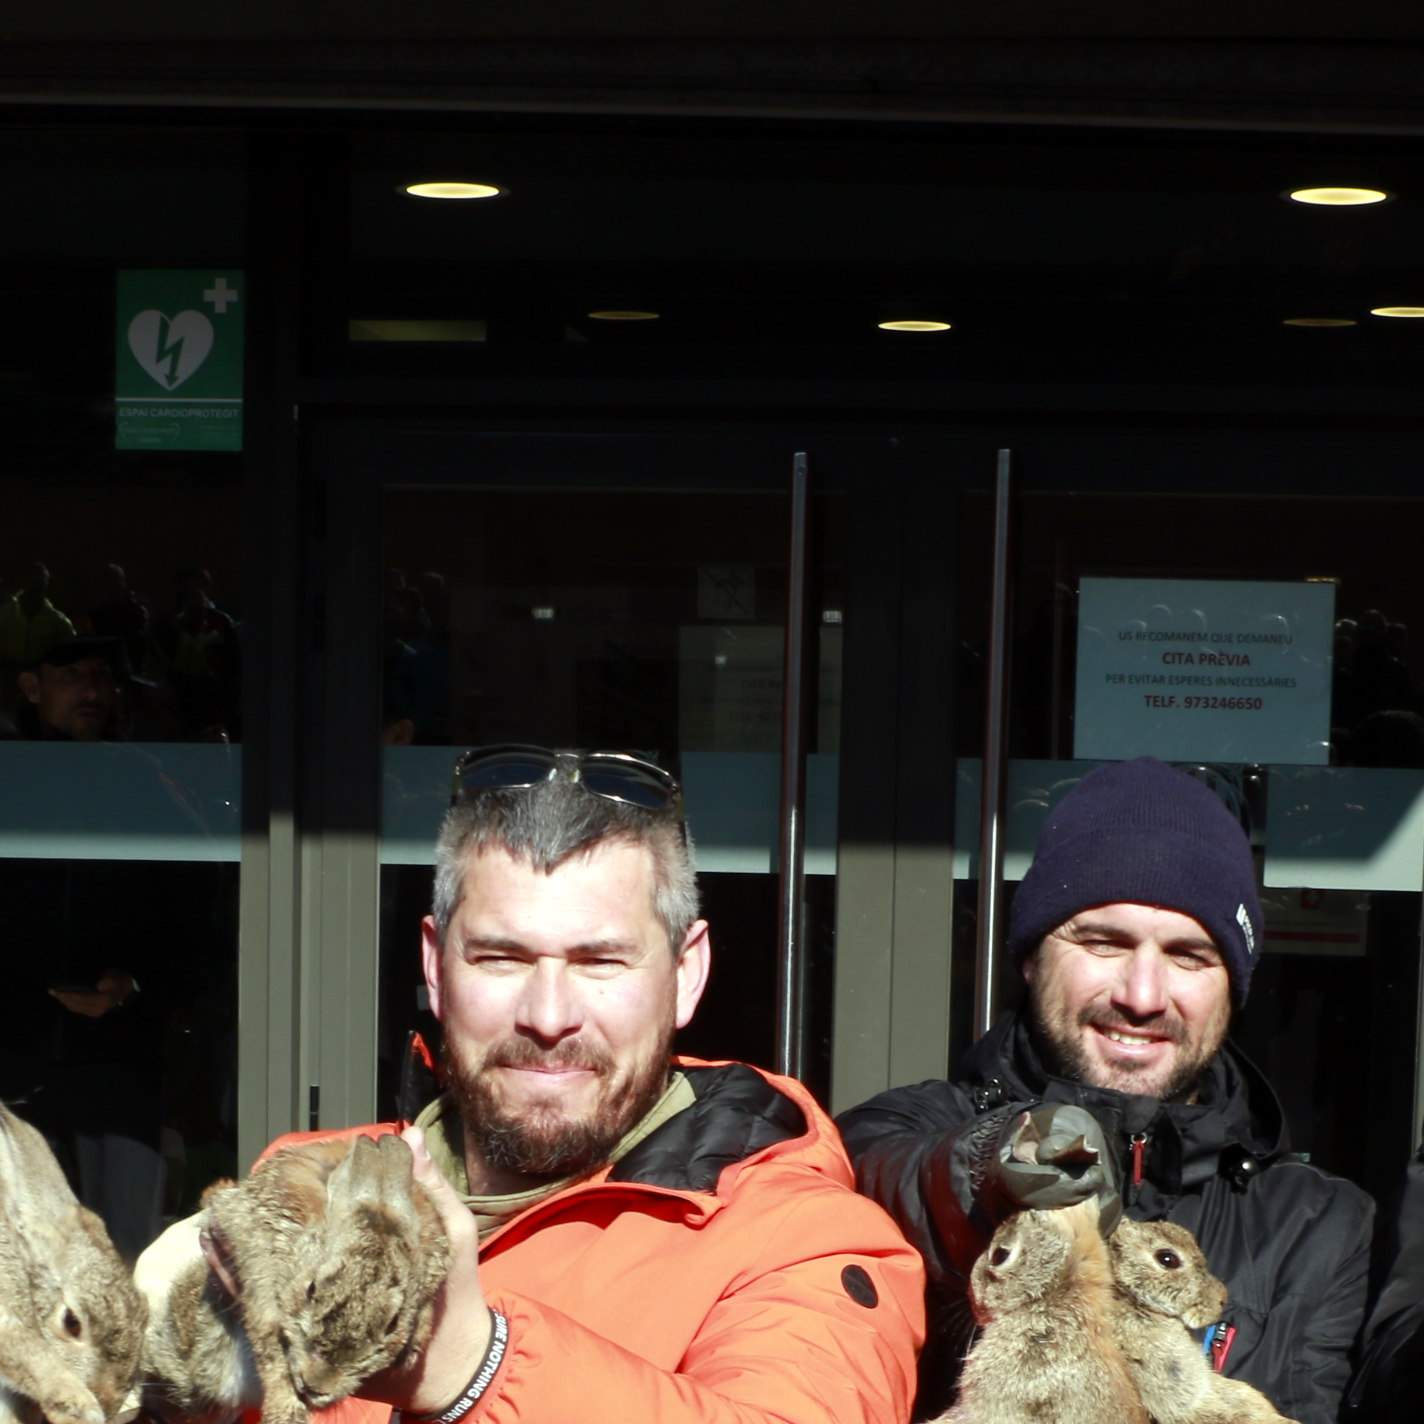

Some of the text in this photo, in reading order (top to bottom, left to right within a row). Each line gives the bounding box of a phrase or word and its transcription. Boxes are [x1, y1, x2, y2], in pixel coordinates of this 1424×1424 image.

[1136, 632, 1209, 643] RECOMANEM
[1211, 633, 1233, 644] QUE
[1162, 651, 1251, 666] CITA PRÈVIA
[1105, 673, 1125, 684] PER
[1128, 673, 1165, 685] EVITAR
[1168, 674, 1213, 686] ESPERES
[1144, 695, 1263, 710] TELF. 973246650
[467, 1340, 506, 1399] NOTHING
[441, 1398, 474, 1423] RUNS
